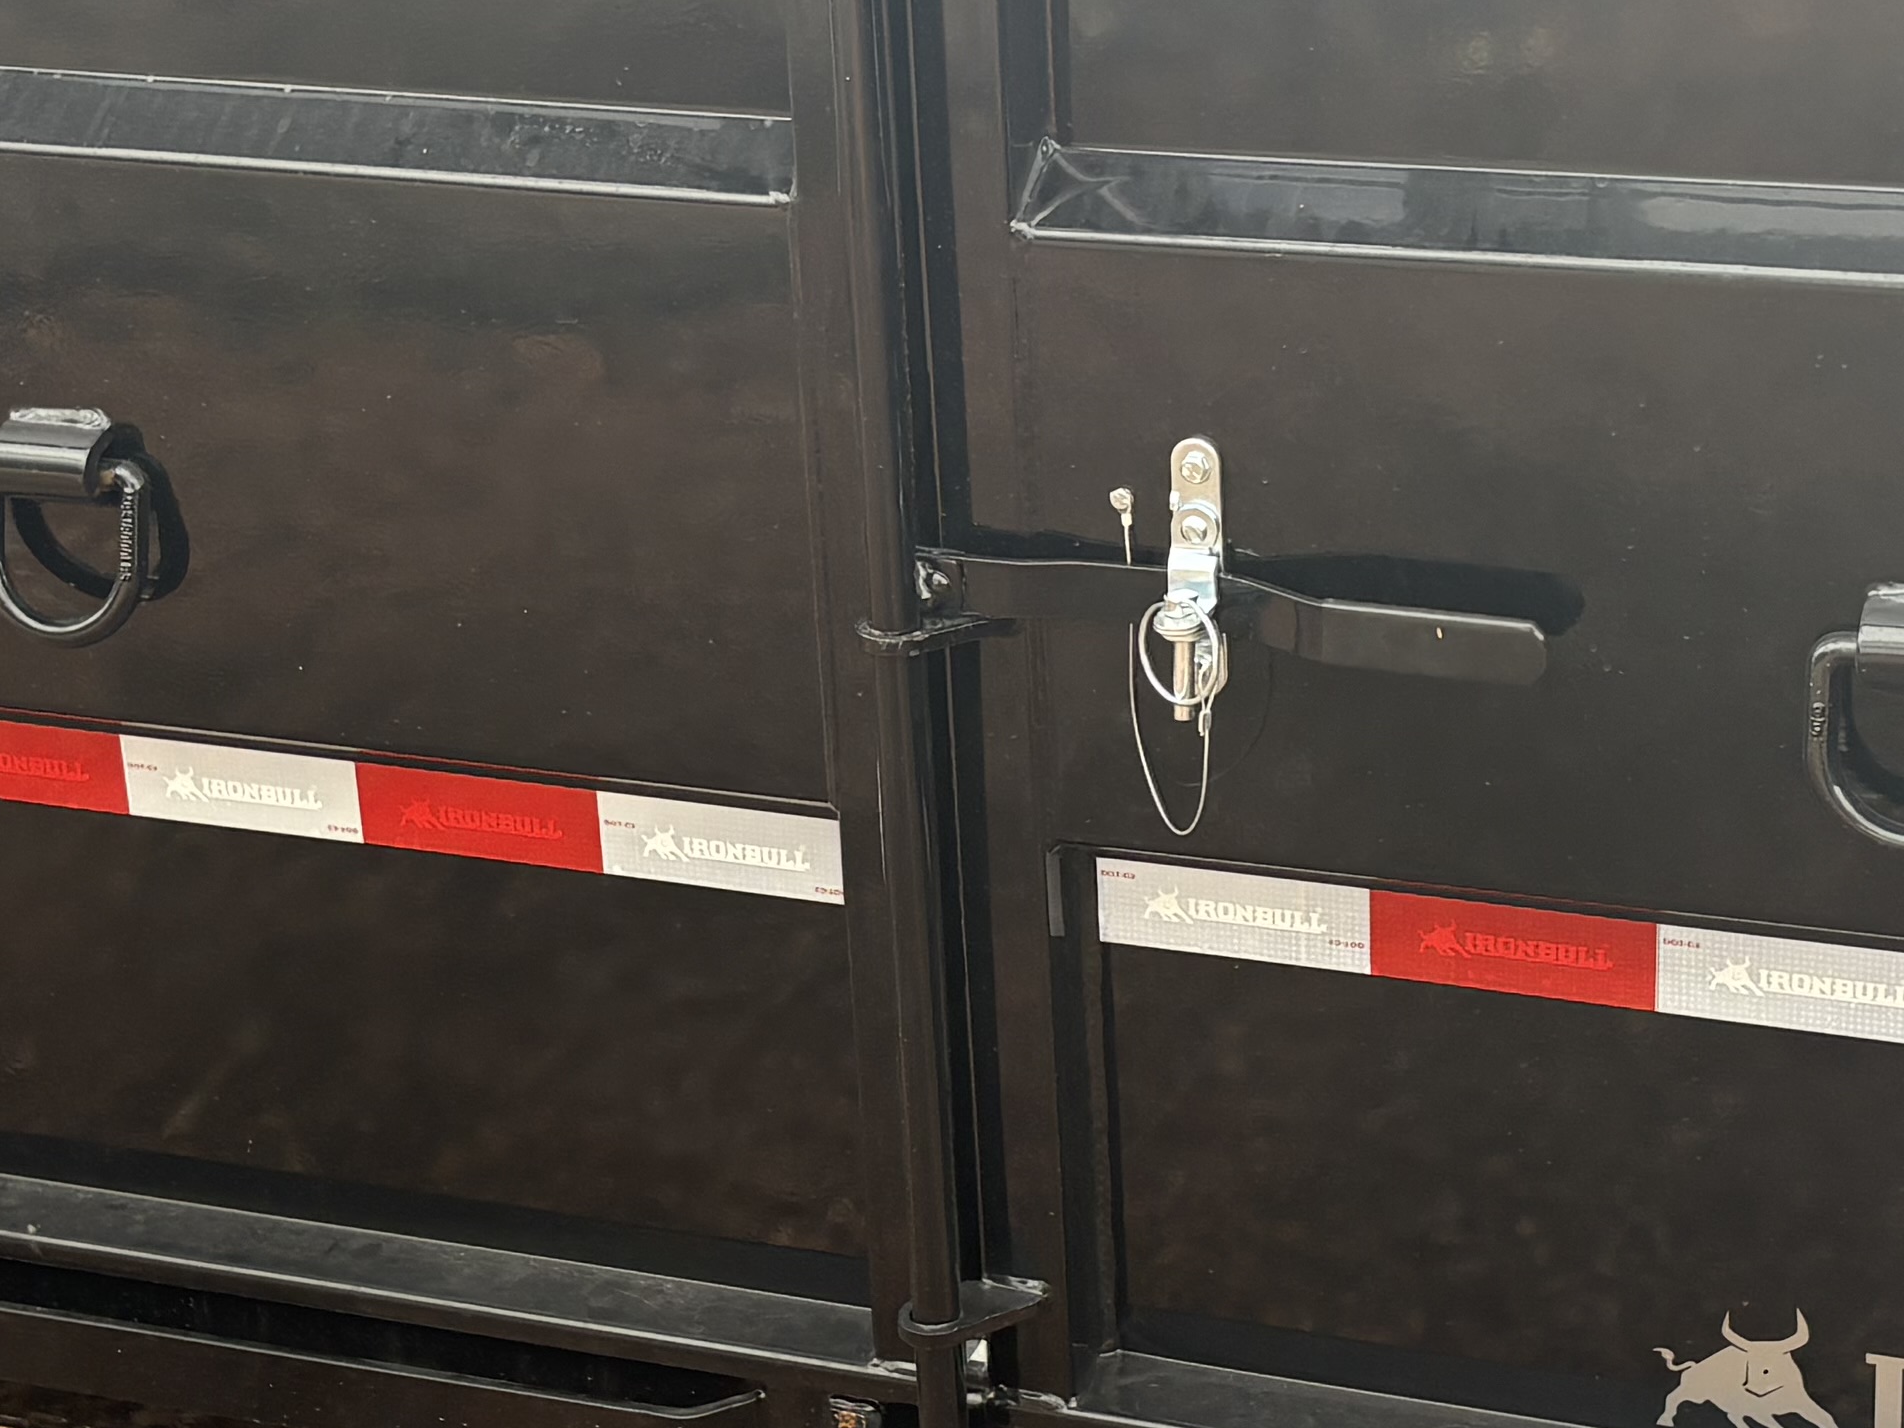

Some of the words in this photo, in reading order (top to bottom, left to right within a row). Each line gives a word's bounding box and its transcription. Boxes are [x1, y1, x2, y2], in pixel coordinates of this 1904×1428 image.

[202, 777, 323, 811] IRONBULL
[437, 805, 563, 840] IRONBULL
[682, 836, 810, 872] IRONBULL
[1188, 897, 1327, 934] IRONBULL
[1465, 931, 1614, 970] IRONBULL
